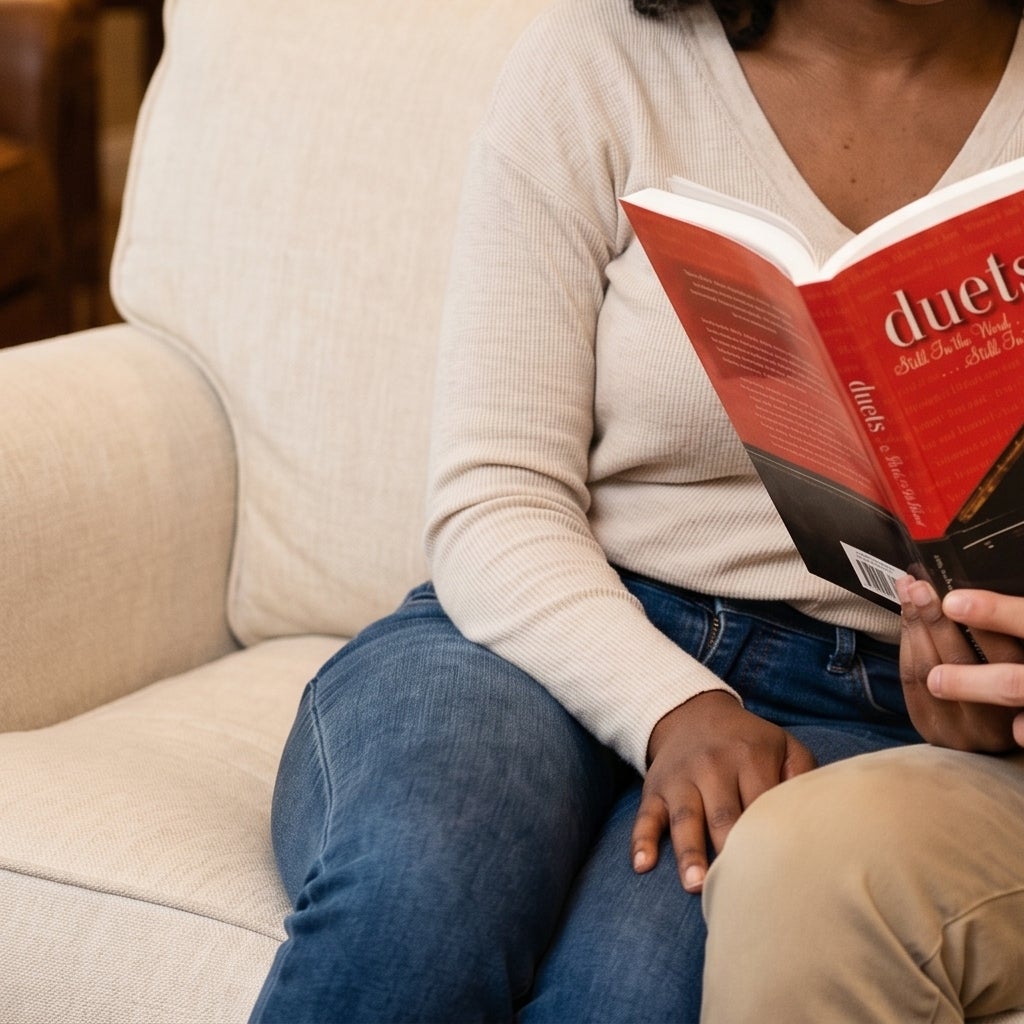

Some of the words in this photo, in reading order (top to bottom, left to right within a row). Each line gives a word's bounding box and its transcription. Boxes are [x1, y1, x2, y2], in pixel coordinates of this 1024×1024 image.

[894, 349, 930, 376] Still
[930, 339, 953, 361] In
[952, 333, 972, 351] the
[971, 313, 1012, 339] Word
[965, 340, 1001, 369] Still
[1001, 329, 1024, 351] In
[848, 380, 886, 433] duets
